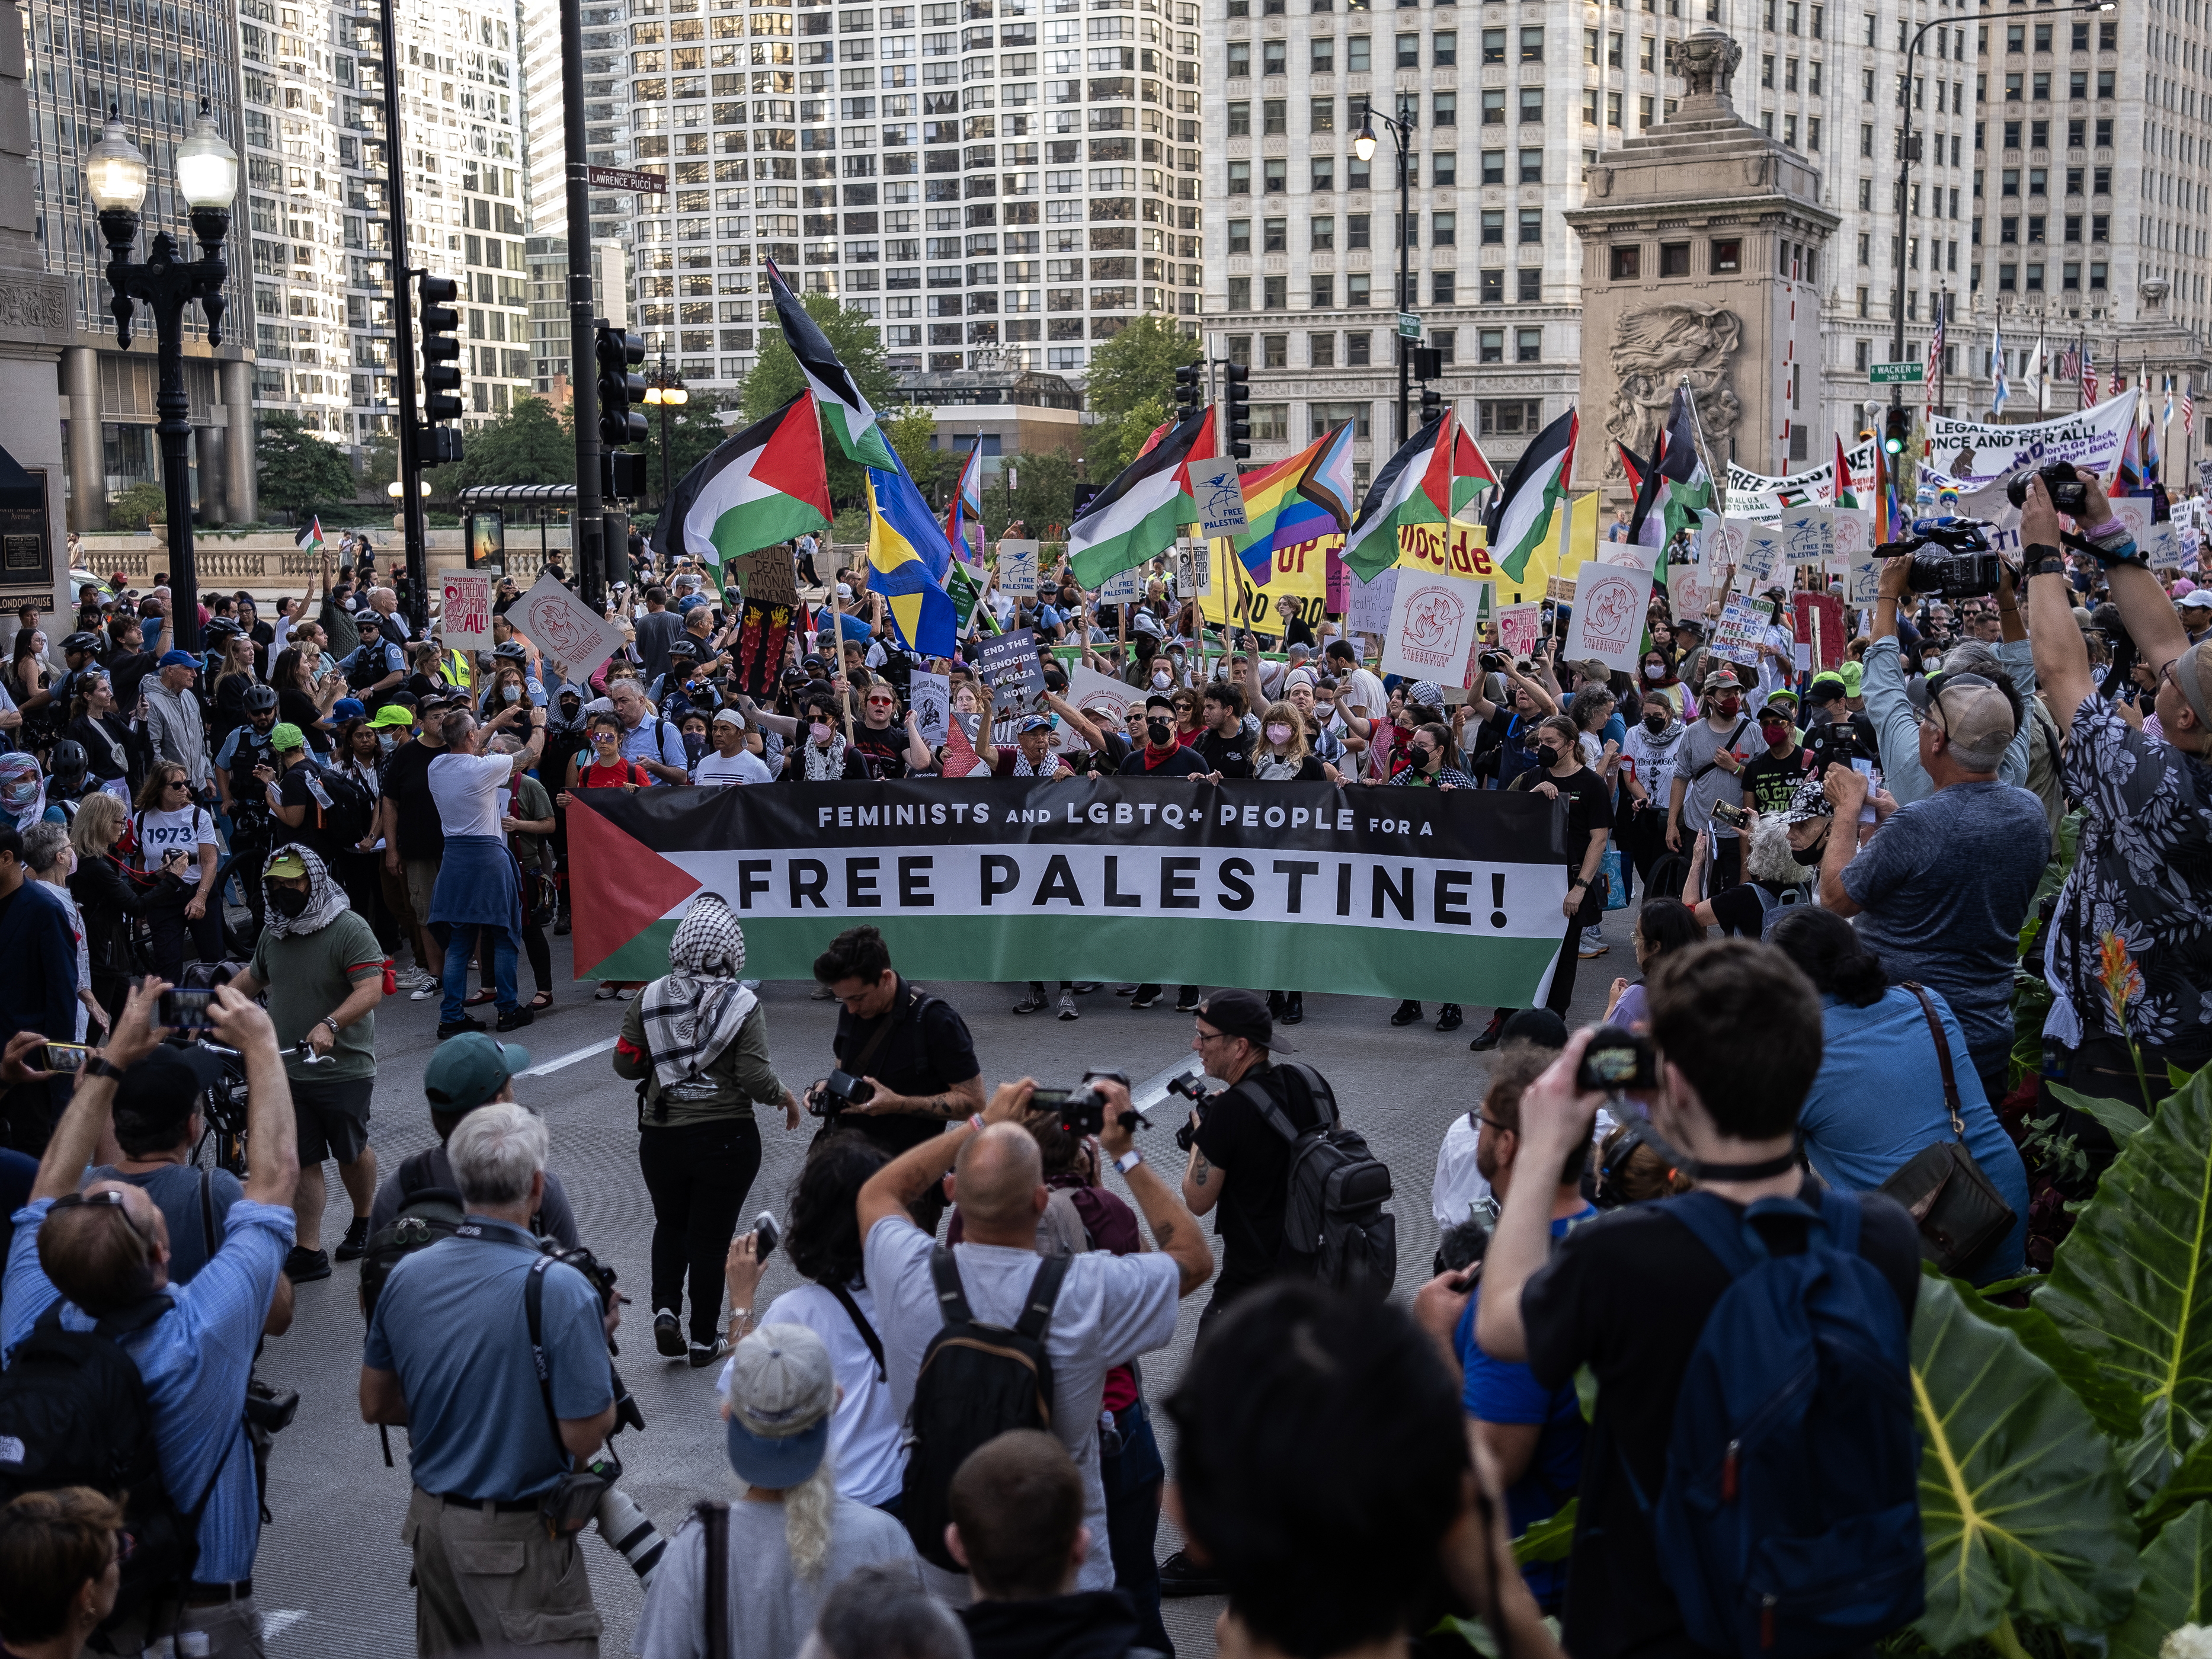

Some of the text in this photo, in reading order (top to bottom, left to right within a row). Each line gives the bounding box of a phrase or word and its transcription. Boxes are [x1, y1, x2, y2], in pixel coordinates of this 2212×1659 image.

[592, 174, 628, 187] LAWRENCE
[631, 180, 651, 190] PUCCI
[1877, 365, 1911, 374] WACKER
[1935, 422, 1990, 434] LEGAL
[1975, 435, 2013, 449] AND
[2019, 432, 2054, 446] FOR
[2059, 424, 2095, 443] ALL!
[2071, 440, 2086, 449] Go
[1727, 467, 1767, 492] FREE
[1223, 508, 1243, 517] FREE
[1204, 517, 1245, 530] PALESTINE
[1918, 521, 1931, 530] AFP
[1803, 543, 1819, 551] FREE
[1787, 550, 1820, 559] PALESTINE
[756, 559, 792, 577] DEATH
[462, 583, 488, 598] FREEDOM
[1104, 588, 1134, 597] PALESTINE
[470, 598, 488, 614] FOR
[1349, 594, 1377, 611] Health
[1727, 591, 1741, 606] LOVE
[1741, 596, 1752, 608] THY
[1501, 607, 1537, 616] REPRODUCTIVE
[1725, 607, 1739, 616] AND
[463, 614, 489, 634] ALL!
[1366, 615, 1377, 629] For
[1517, 613, 1538, 626] FREEDOM
[1720, 620, 1742, 632] FREE
[1523, 624, 1538, 638] FOR
[1723, 629, 1745, 638] FREE
[568, 632, 601, 662] PALESTINIAN
[984, 638, 1029, 657] END THE
[1583, 636, 1625, 649] PALESTINIAN
[1584, 643, 1622, 655] LIBERATION
[1715, 636, 1755, 649] PALESTIN
[574, 638, 604, 665] LIBERATION
[1402, 648, 1449, 663] PALESTINIAN
[983, 652, 1037, 672] GENOCIDE
[1403, 654, 1446, 668] LIBERATION
[991, 668, 1035, 686] IN GAZA
[917, 680, 930, 691] choose
[1003, 686, 1031, 699] NOW!
[1076, 690, 1124, 709] REPRODUCTIVE JUSTICE
[1635, 757, 1675, 767] ABORTION
[819, 802, 1433, 836] FEMINISTS AND LGBTQ+ PEOPLE FOR A
[146, 827, 193, 844] 1973
[738, 854, 1508, 930] FREE PALESTINE!
